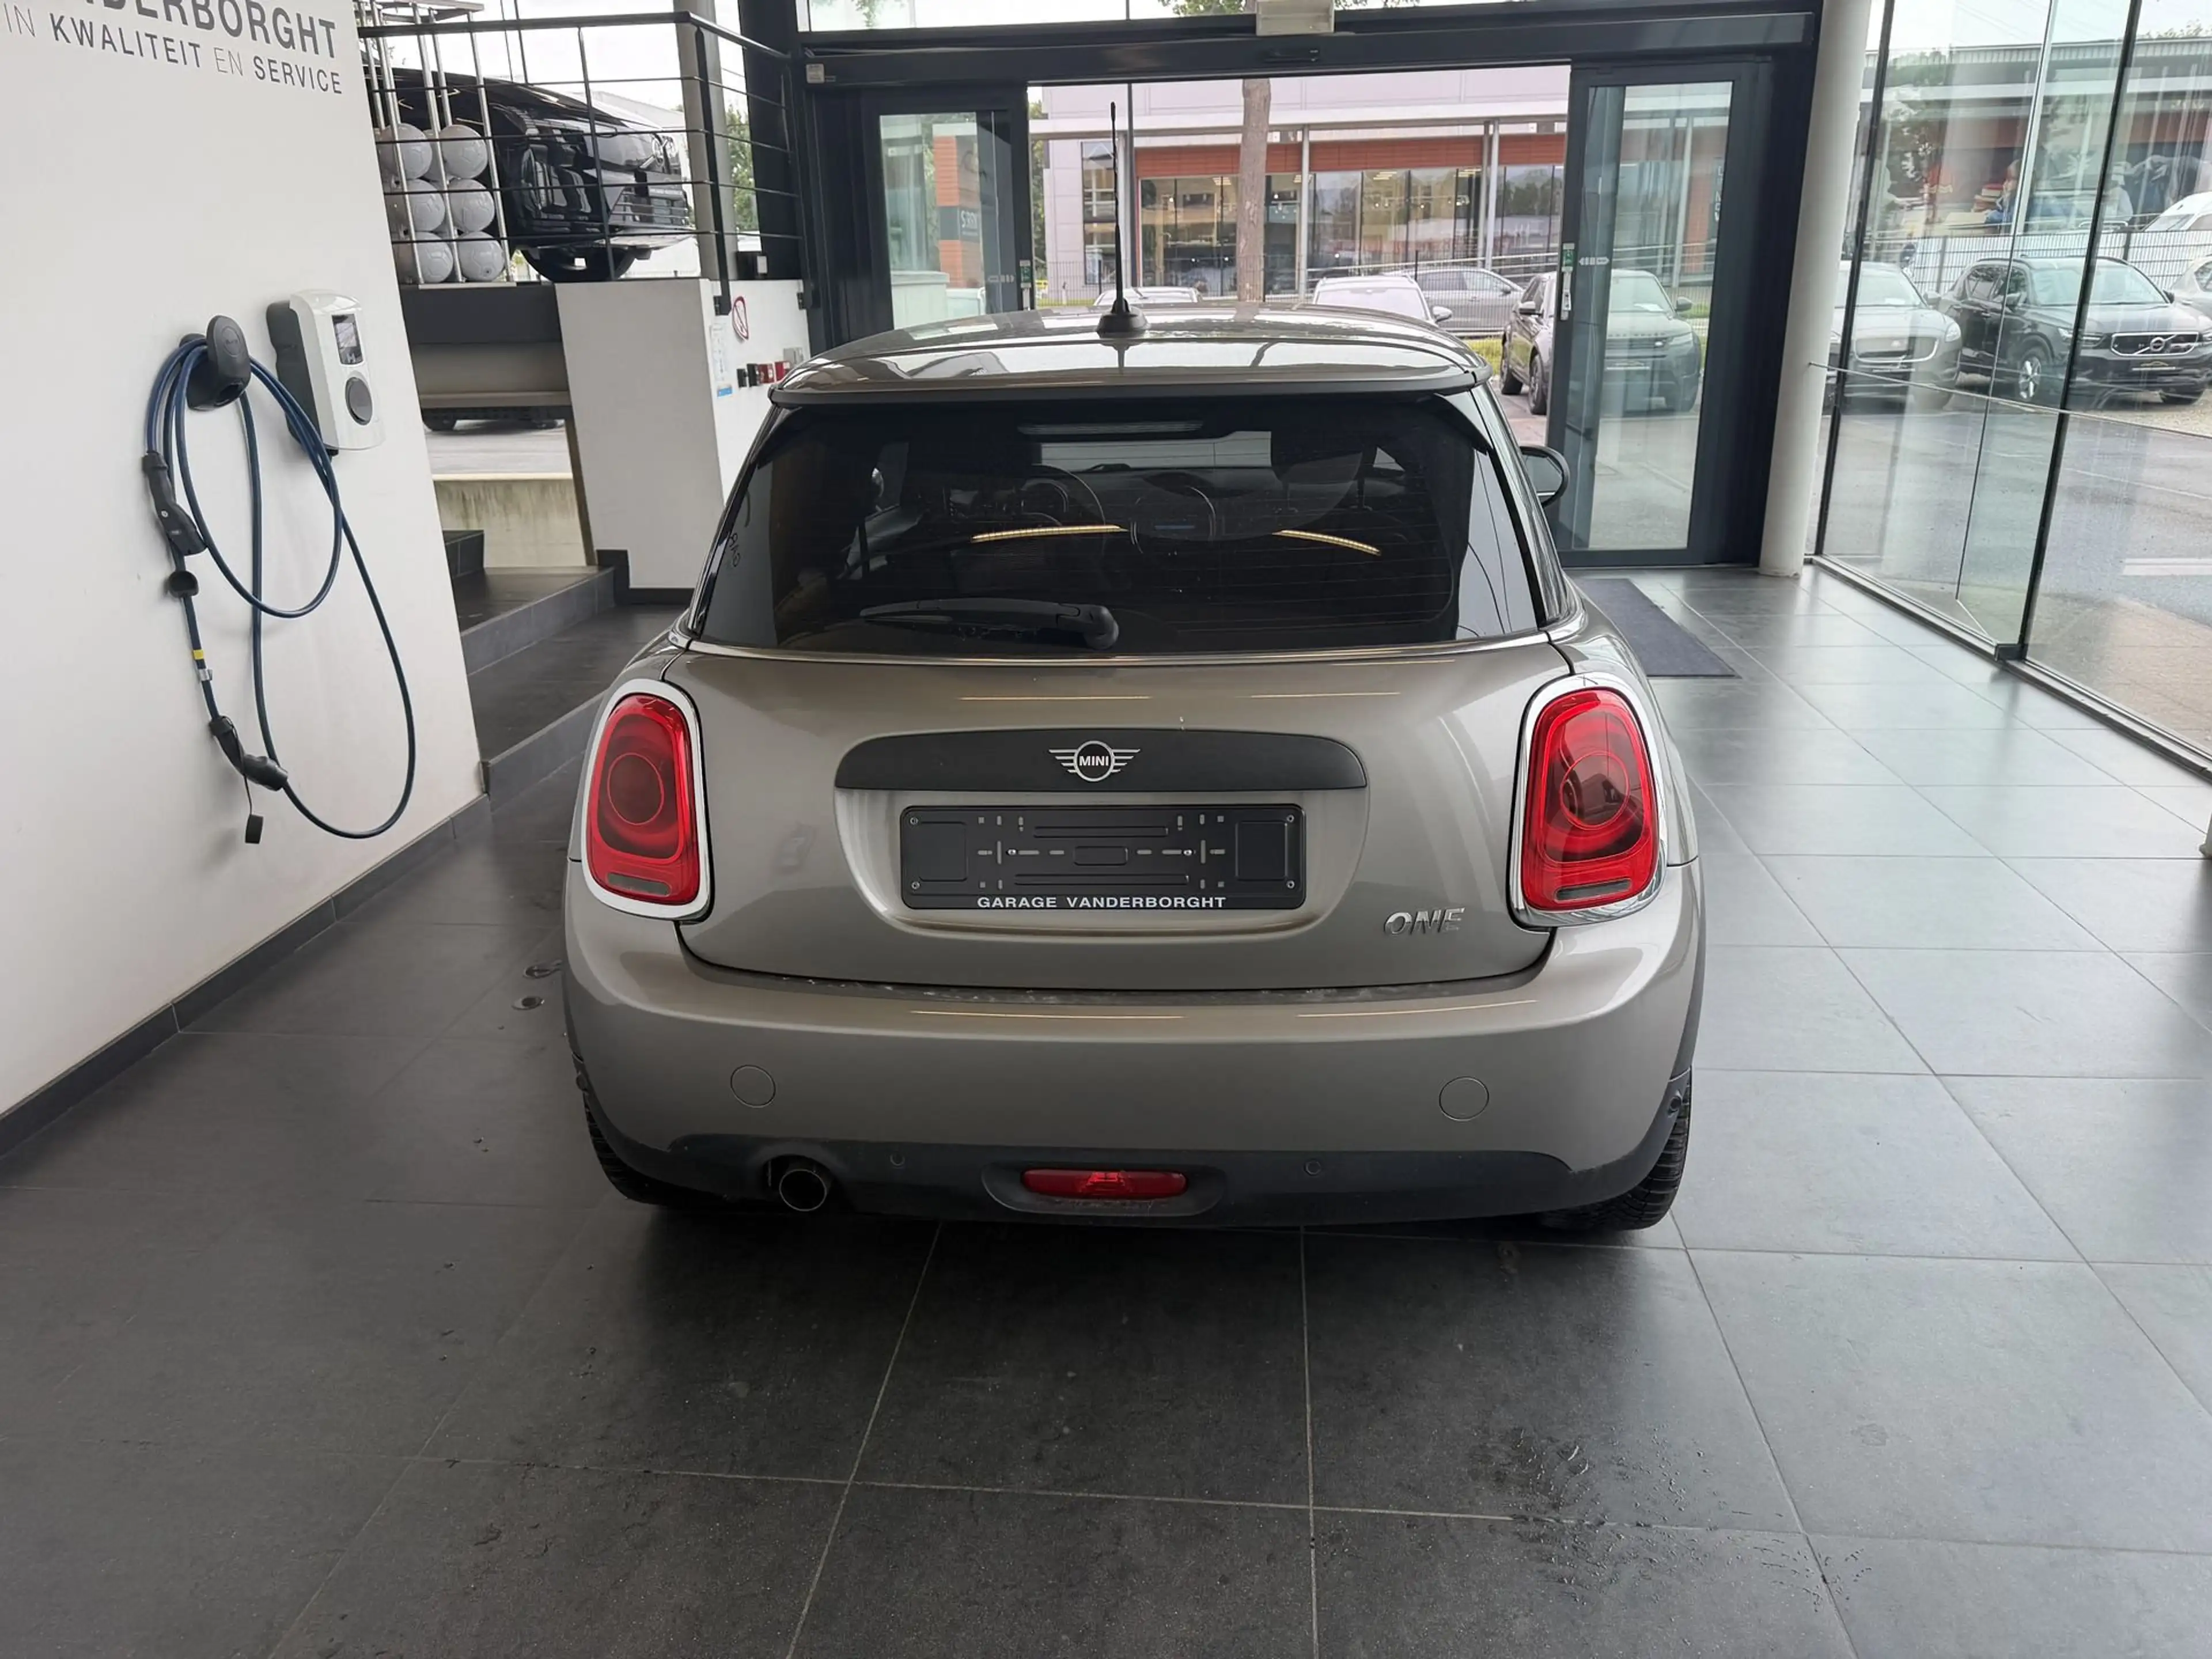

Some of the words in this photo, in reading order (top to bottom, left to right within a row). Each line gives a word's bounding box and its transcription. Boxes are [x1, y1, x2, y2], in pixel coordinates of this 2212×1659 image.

[3, 2, 36, 38] IN
[50, 12, 201, 69] KWALITEIT
[213, 47, 244, 77] EN
[254, 55, 343, 94] SERVICE
[1079, 755, 1109, 766] MINI
[978, 896, 1058, 909] GARAGE
[1067, 896, 1226, 909] VANDERBORGHT
[1384, 907, 1465, 935] ONE
